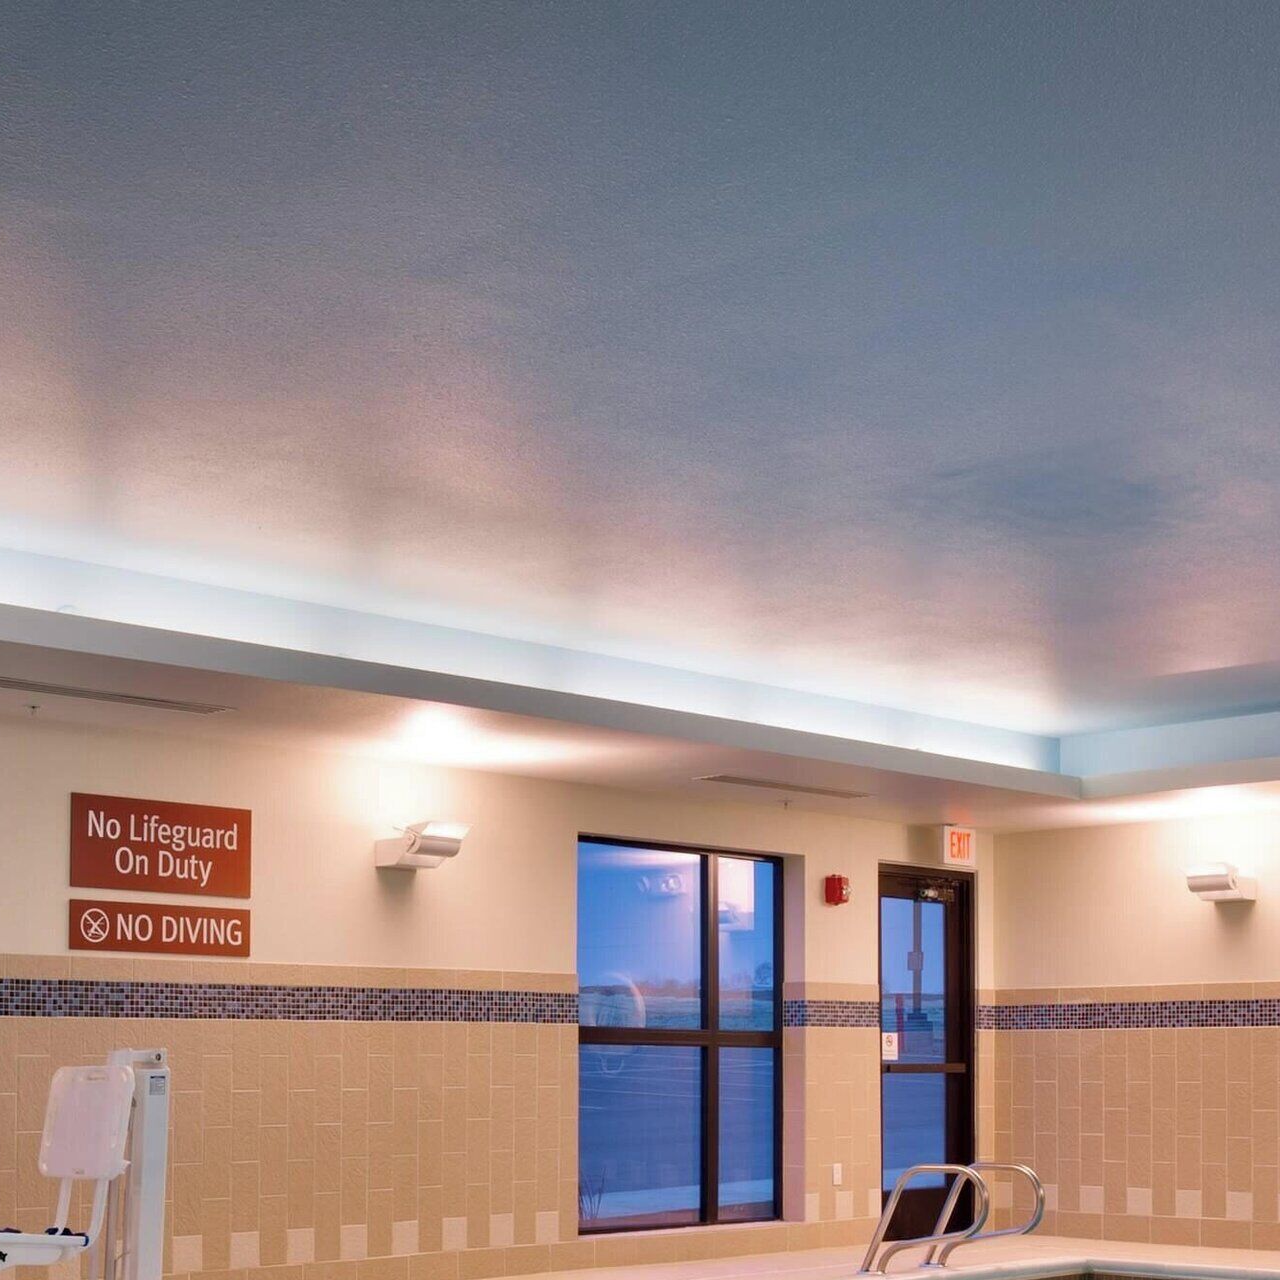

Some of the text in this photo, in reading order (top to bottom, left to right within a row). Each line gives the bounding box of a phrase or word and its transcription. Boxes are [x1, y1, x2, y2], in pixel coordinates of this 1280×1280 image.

[88, 810, 238, 851] No Lifeguard
[950, 832, 971, 859] EXIT
[115, 847, 212, 887] On Duty
[117, 914, 242, 945] NO DIVING
